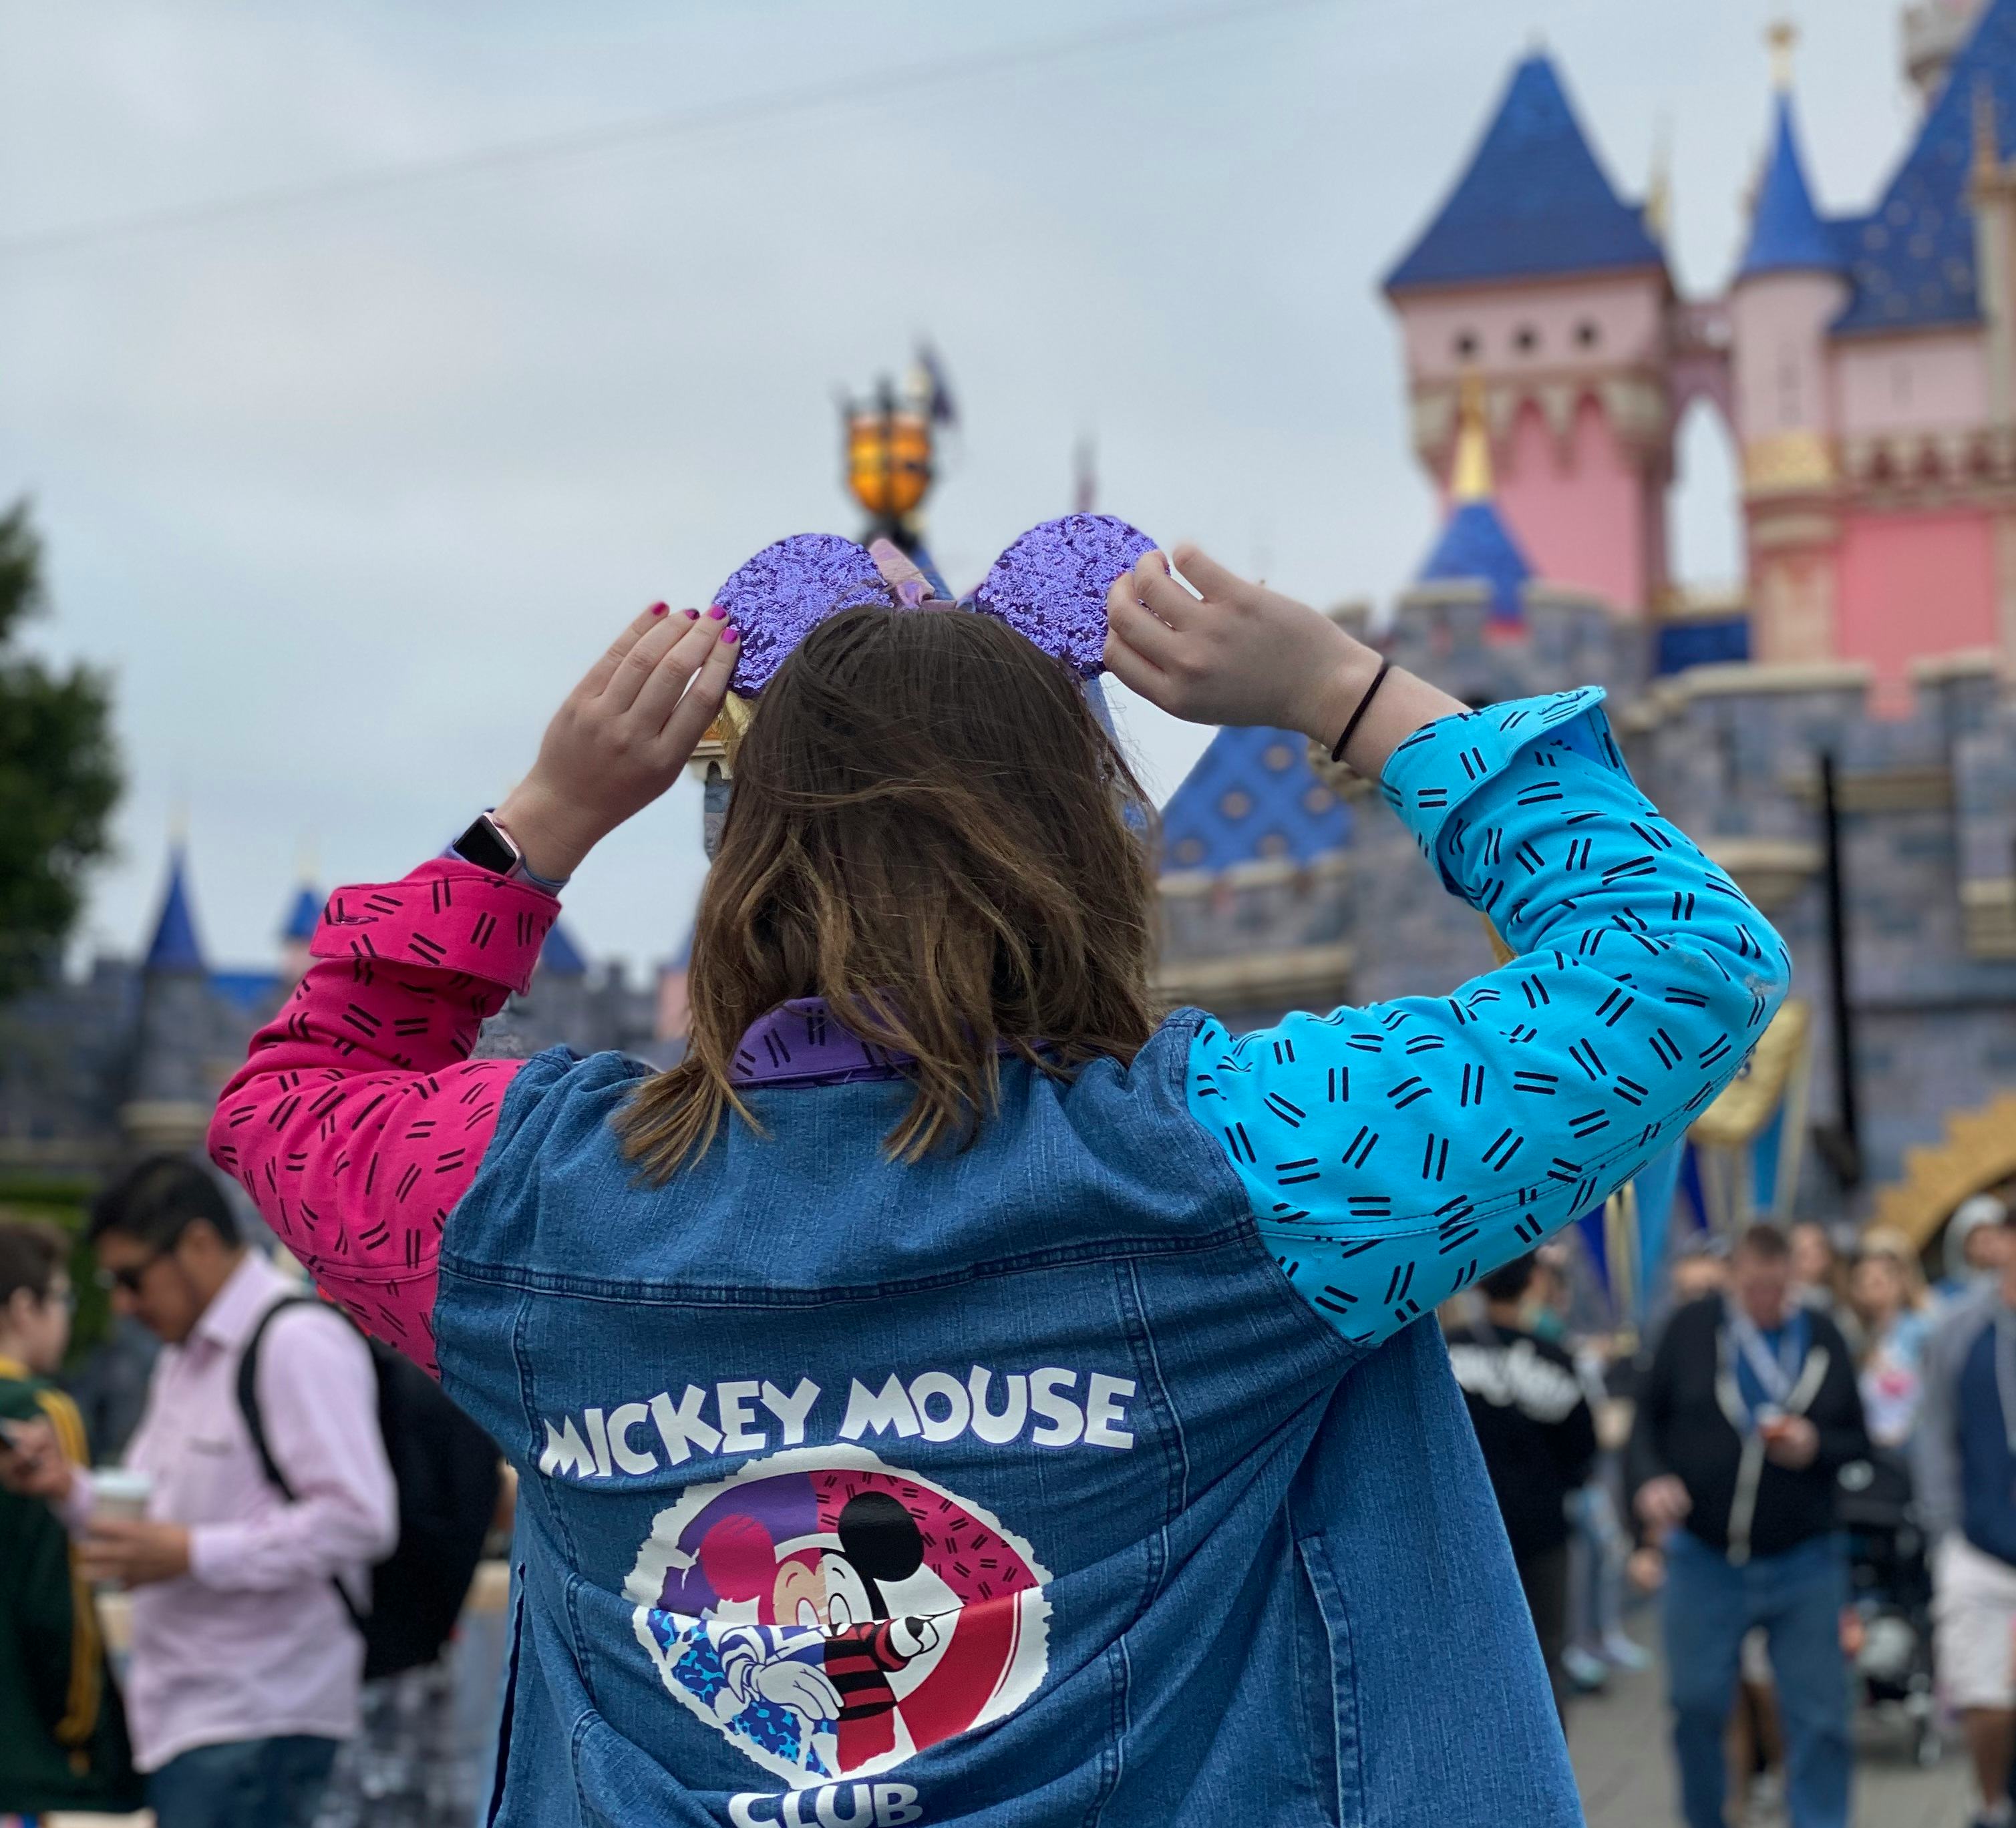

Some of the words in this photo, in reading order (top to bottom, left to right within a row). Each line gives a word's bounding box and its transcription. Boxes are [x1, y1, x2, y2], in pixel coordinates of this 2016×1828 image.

[538, 1377, 822, 1479] MICKEY
[838, 1364, 1137, 1450] MOUSE
[728, 1783, 924, 1828] CLUB
